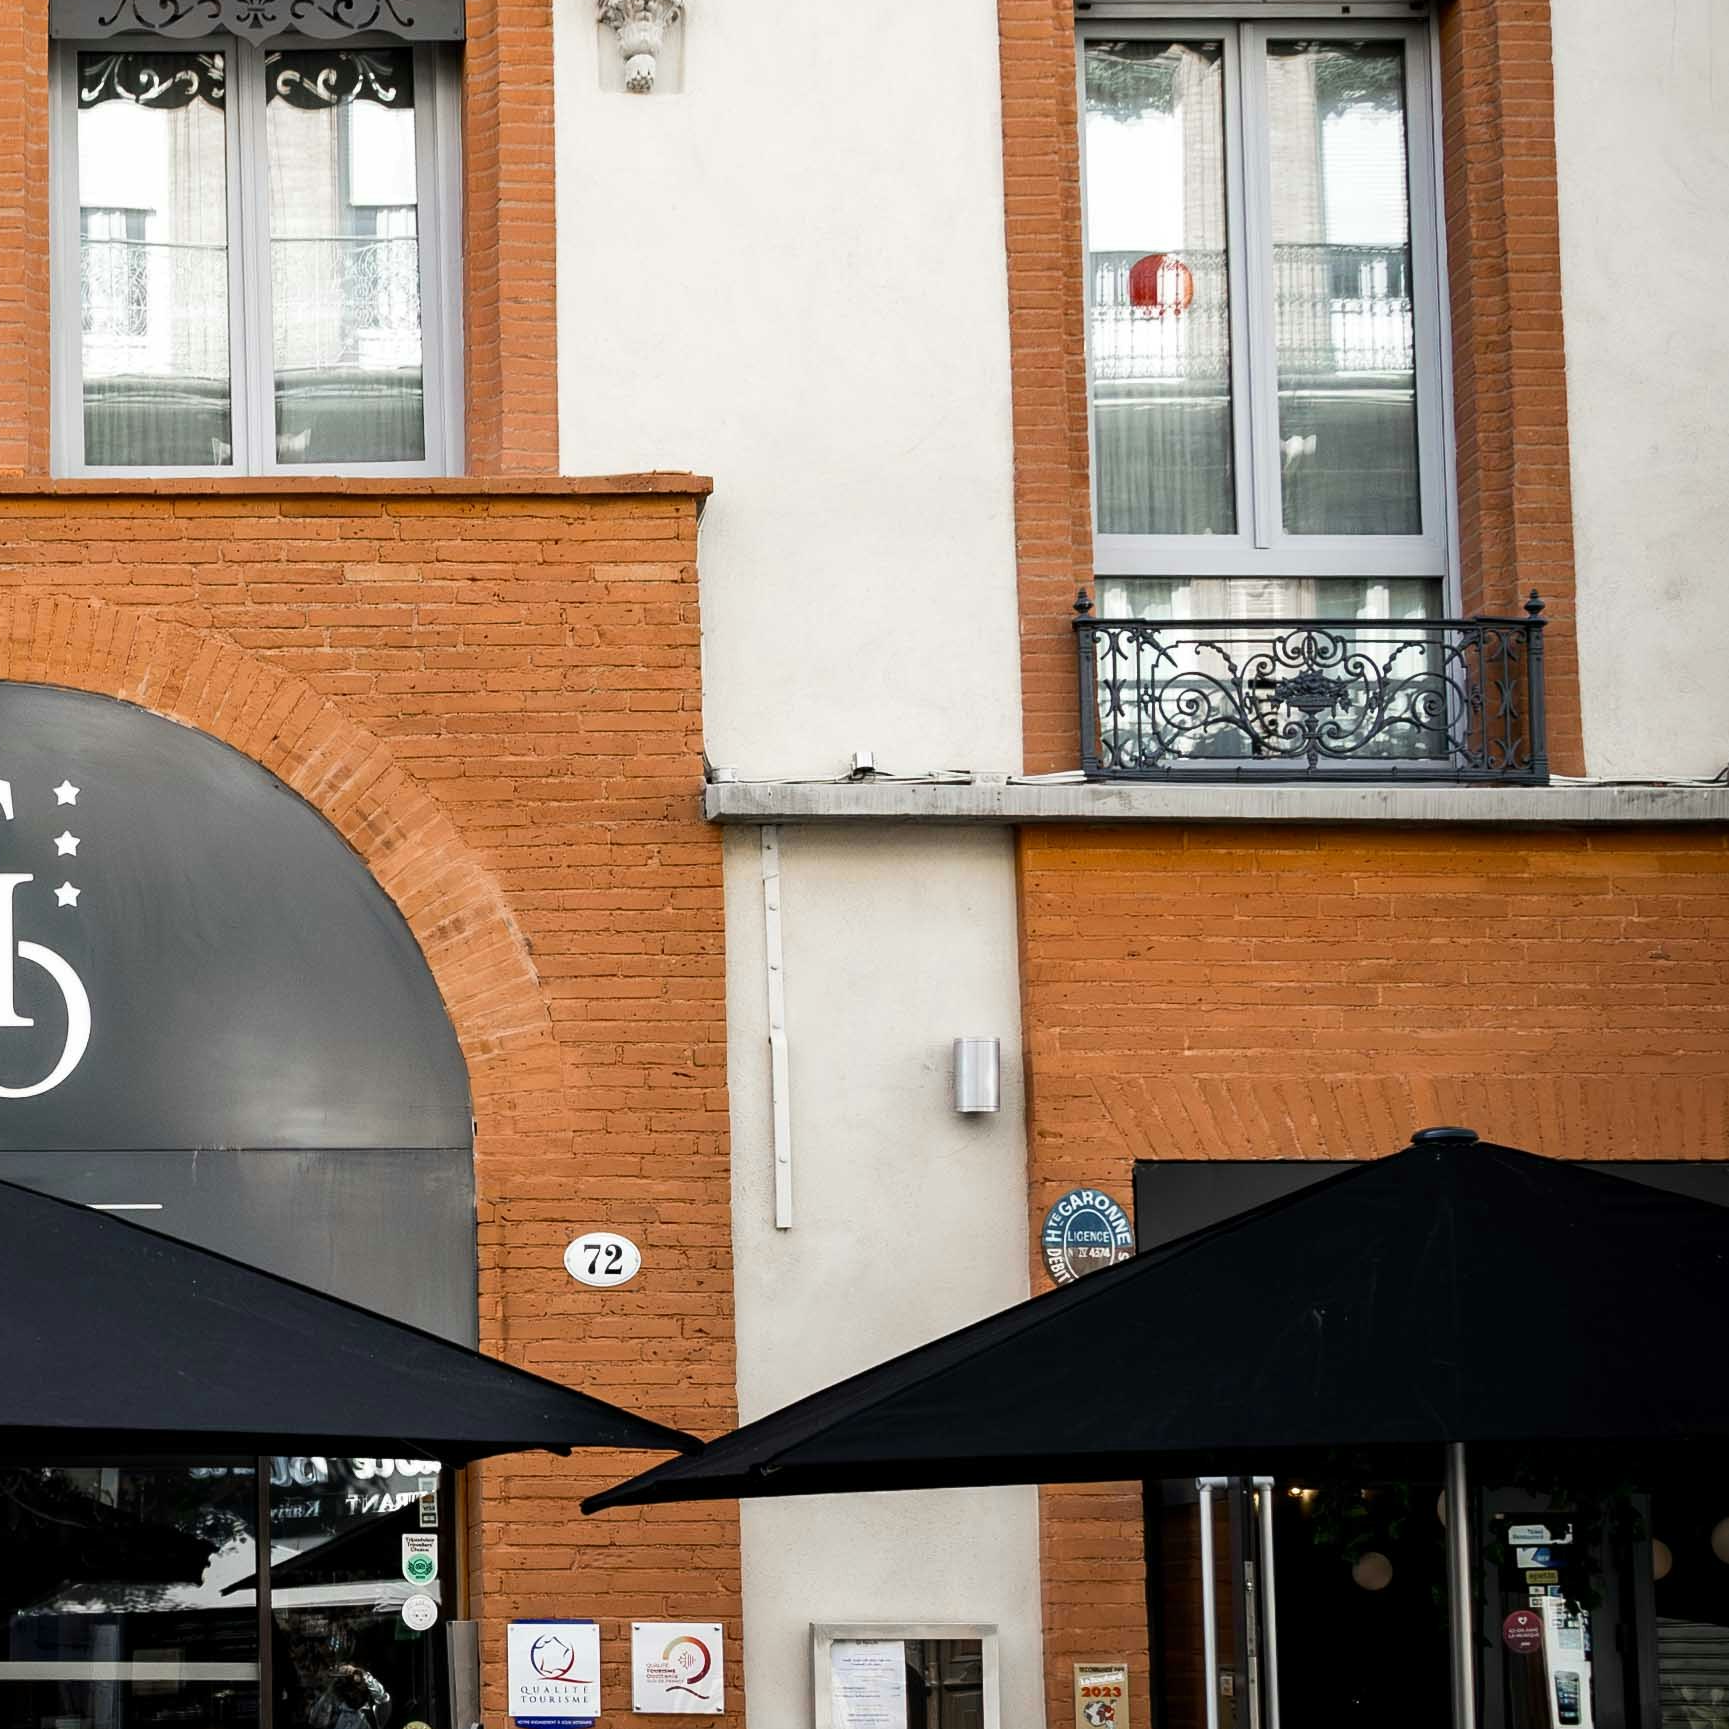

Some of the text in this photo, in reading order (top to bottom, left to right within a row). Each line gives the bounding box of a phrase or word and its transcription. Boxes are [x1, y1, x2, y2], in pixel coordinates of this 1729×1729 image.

[1057, 1189, 1132, 1246] GARONNE
[1067, 1230, 1110, 1244] LICENCE
[583, 1243, 623, 1275] 72
[1080, 1686, 1122, 1697] 2023
[520, 1695, 590, 1704] TOURISME
